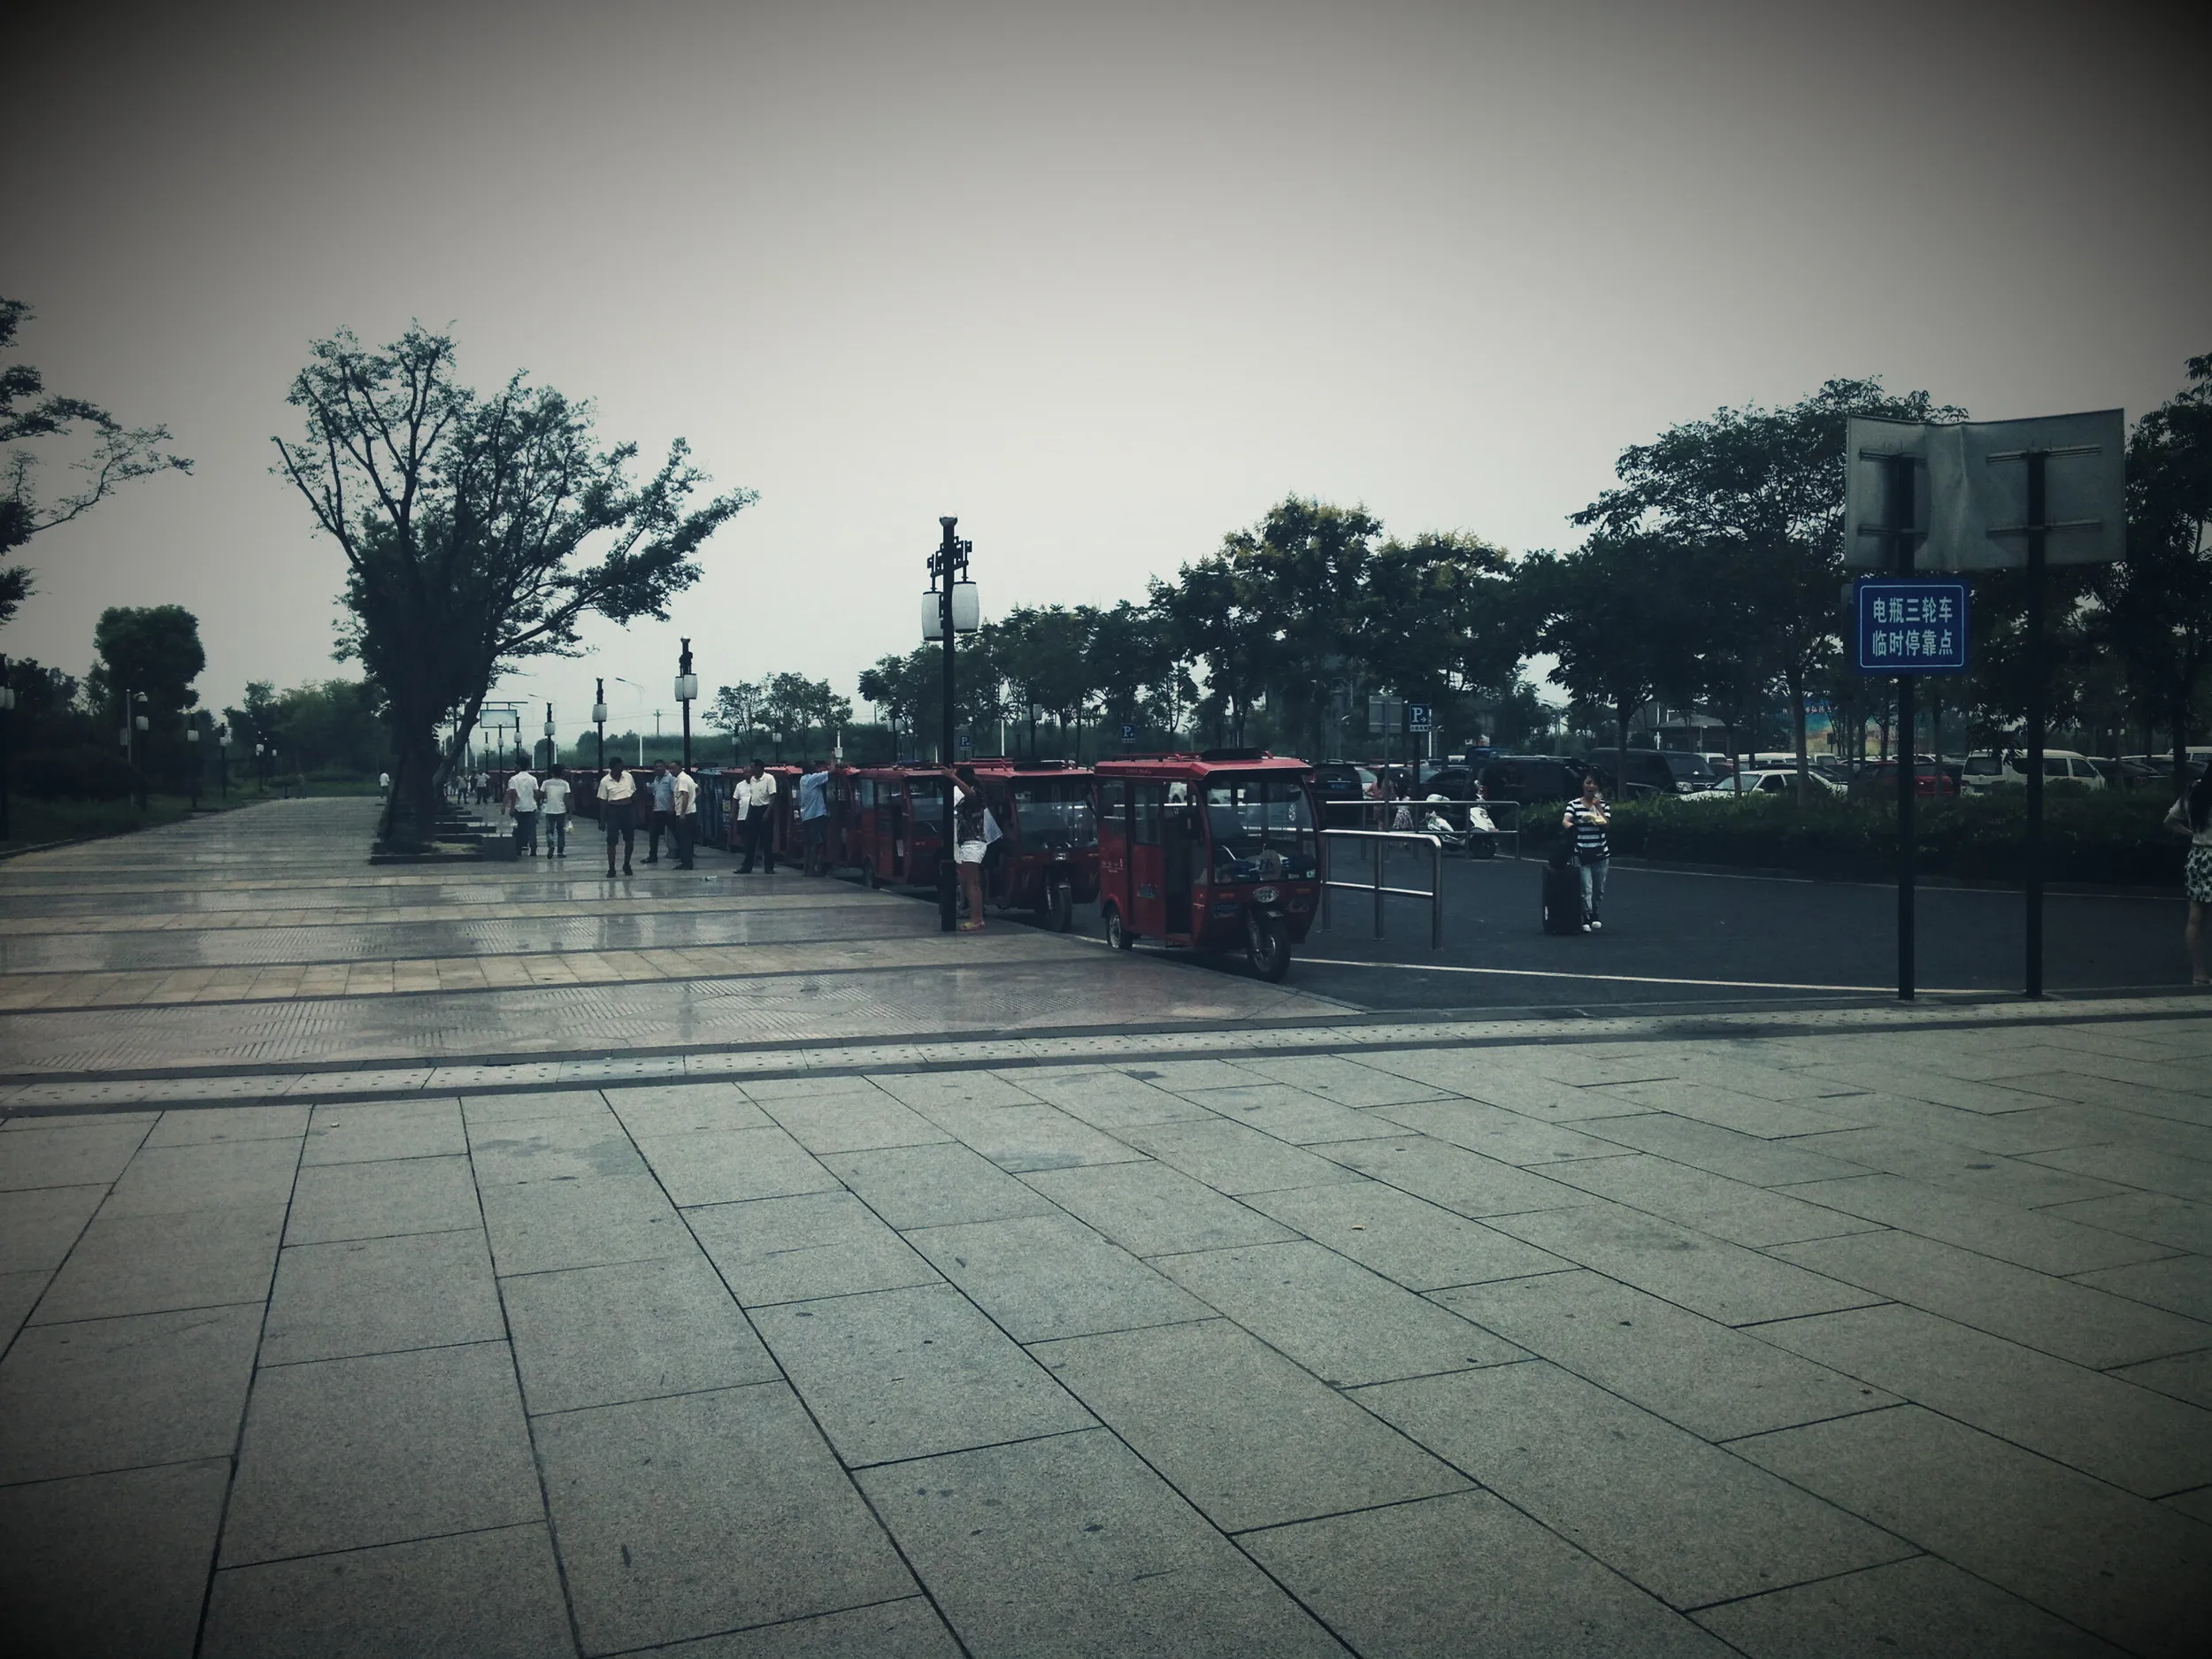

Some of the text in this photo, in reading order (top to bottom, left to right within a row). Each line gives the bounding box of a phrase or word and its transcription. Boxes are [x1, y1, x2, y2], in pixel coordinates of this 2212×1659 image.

[1873, 596, 1953, 623] 电瓶三轮车
[1872, 629, 1953, 657] 临时停靠点
[1411, 707, 1424, 723] P
[1123, 726, 1132, 737] P
